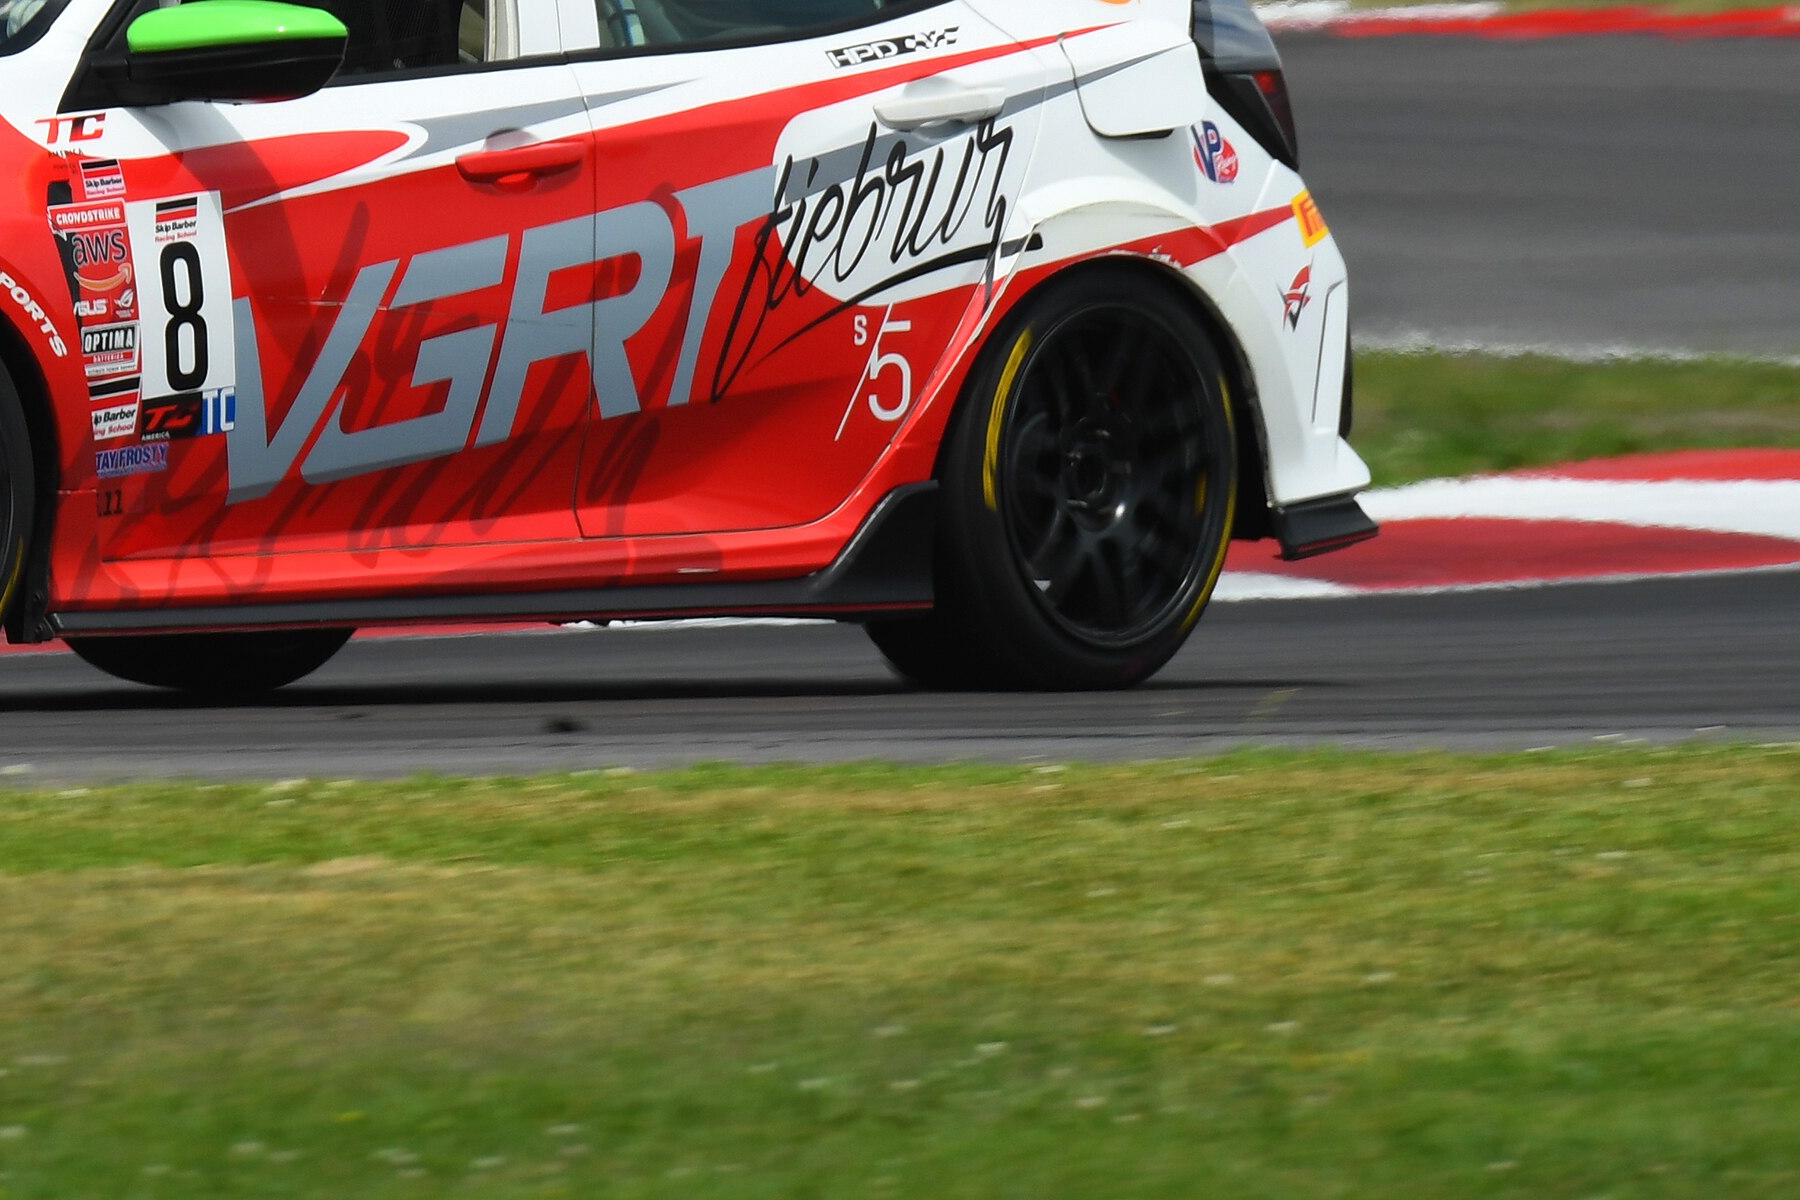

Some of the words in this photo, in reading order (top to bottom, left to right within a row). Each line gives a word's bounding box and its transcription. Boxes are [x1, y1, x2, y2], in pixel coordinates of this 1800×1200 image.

[827, 41, 899, 67] HPD
[34, 112, 106, 144] TC
[1190, 120, 1221, 182] VP
[172, 220, 197, 231] Barber
[71, 229, 127, 268] aws
[73, 298, 108, 317] ASUS
[160, 241, 209, 391] 8
[84, 328, 134, 353] OPTIMA
[227, 165, 778, 506] VGRT
[103, 408, 136, 422] Barber
[203, 388, 235, 435] TC
